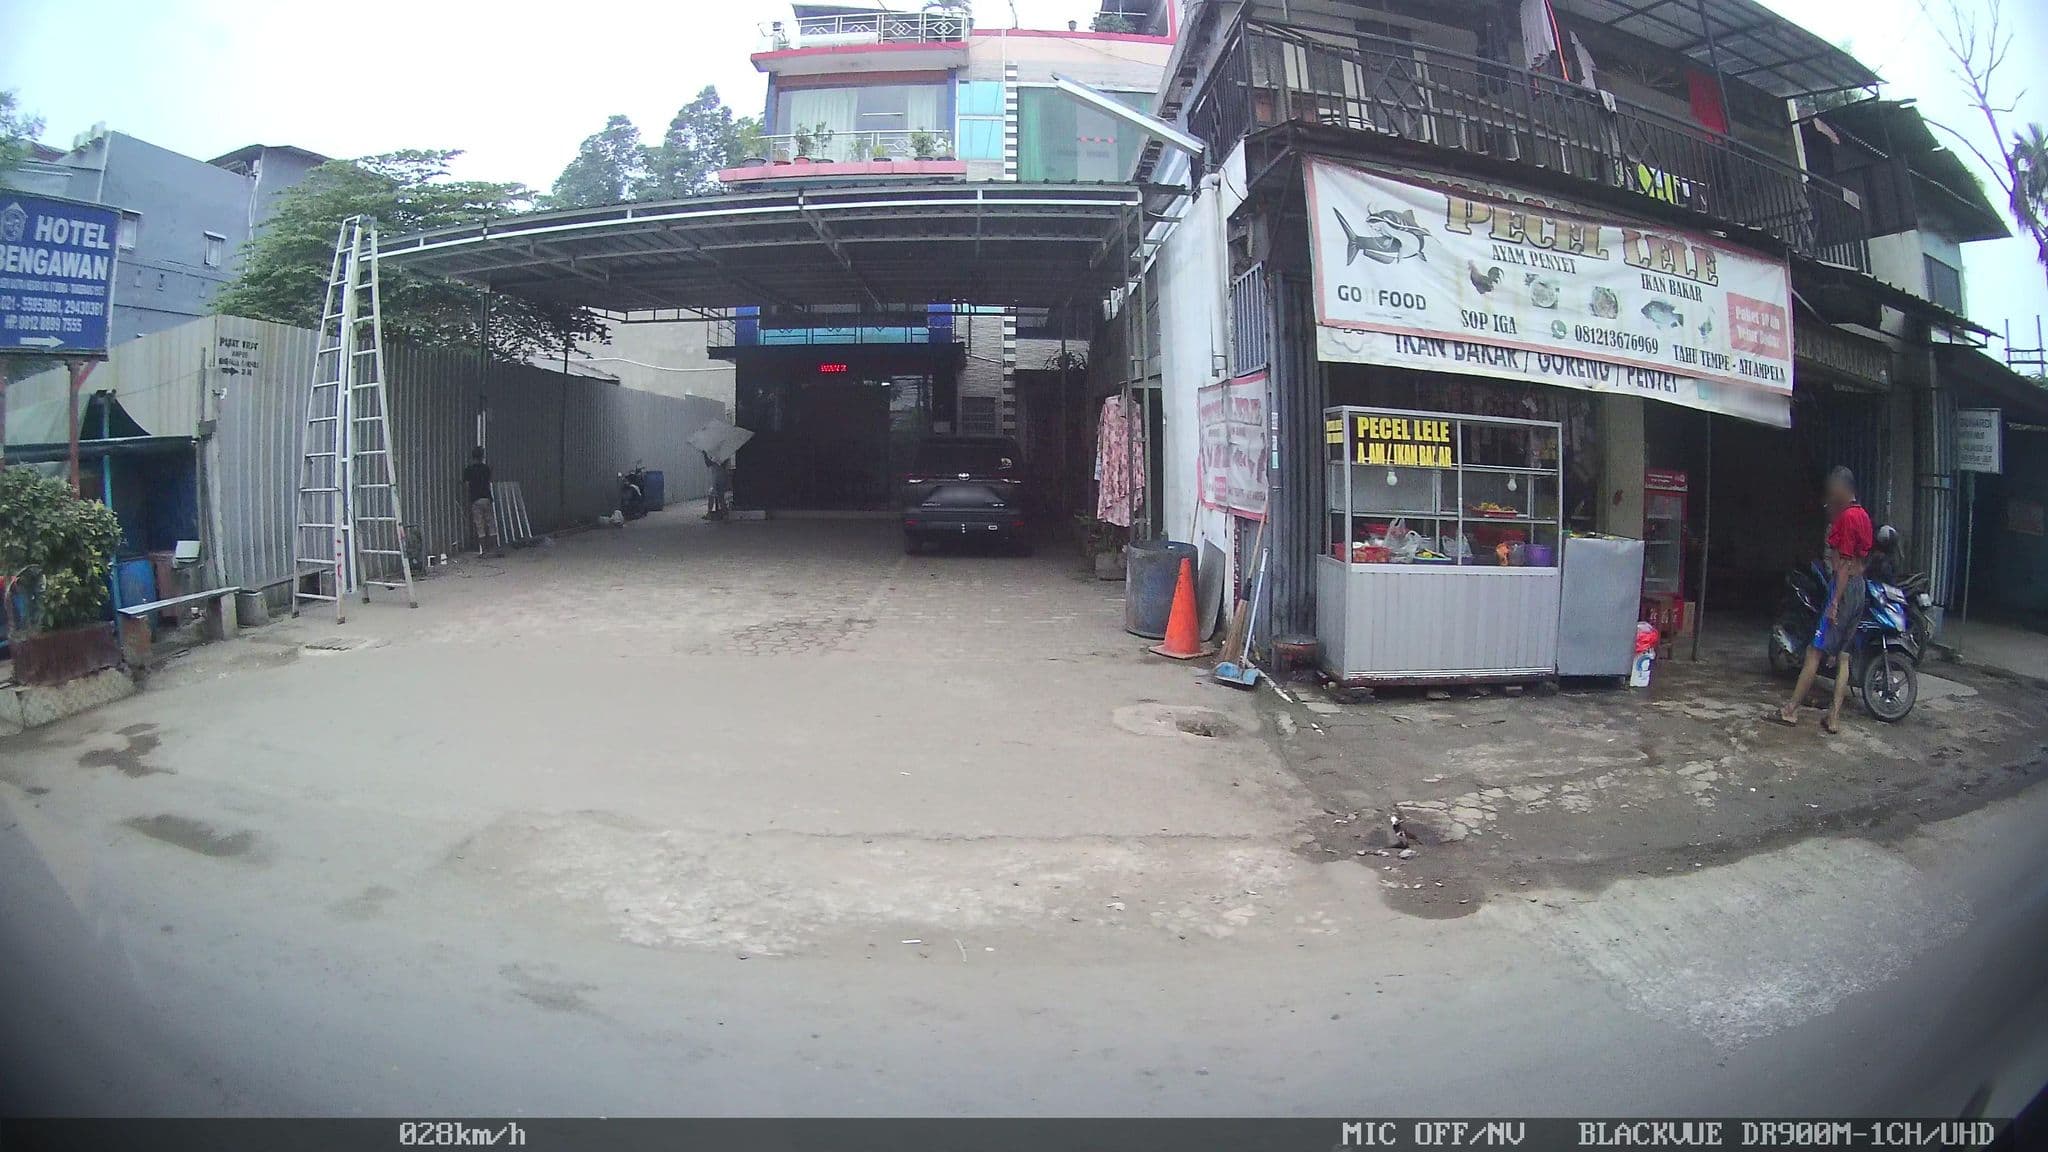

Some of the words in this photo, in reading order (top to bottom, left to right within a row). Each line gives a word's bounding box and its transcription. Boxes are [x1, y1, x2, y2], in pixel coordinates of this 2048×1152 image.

[35, 215, 110, 249] HOTEL
[1445, 196, 1609, 260] PECEL
[1622, 227, 1719, 287] LELE
[1492, 244, 1526, 266] AYAM
[1529, 250, 1577, 274] PENYET
[1337, 284, 1362, 303] GO
[1378, 289, 1427, 311] FOOD
[1640, 273, 1668, 294] IKAN
[1669, 278, 1703, 303] BAKAR
[1460, 309, 1489, 330] SOP
[1493, 313, 1518, 334] IGA
[1574, 324, 1659, 354] 081213676969
[1395, 333, 1448, 358] IKAN
[1453, 339, 1519, 369] BAKAR
[1537, 352, 1610, 382] GORENG
[1672, 344, 1698, 365] TAHU
[1700, 350, 1730, 371] TEMPE
[1739, 358, 1752, 376] ATI
[1754, 361, 1786, 383] AMPELA
[1357, 416, 1411, 440] PECEL
[1414, 419, 1450, 442] LELE
[1357, 442, 1385, 464] AAM
